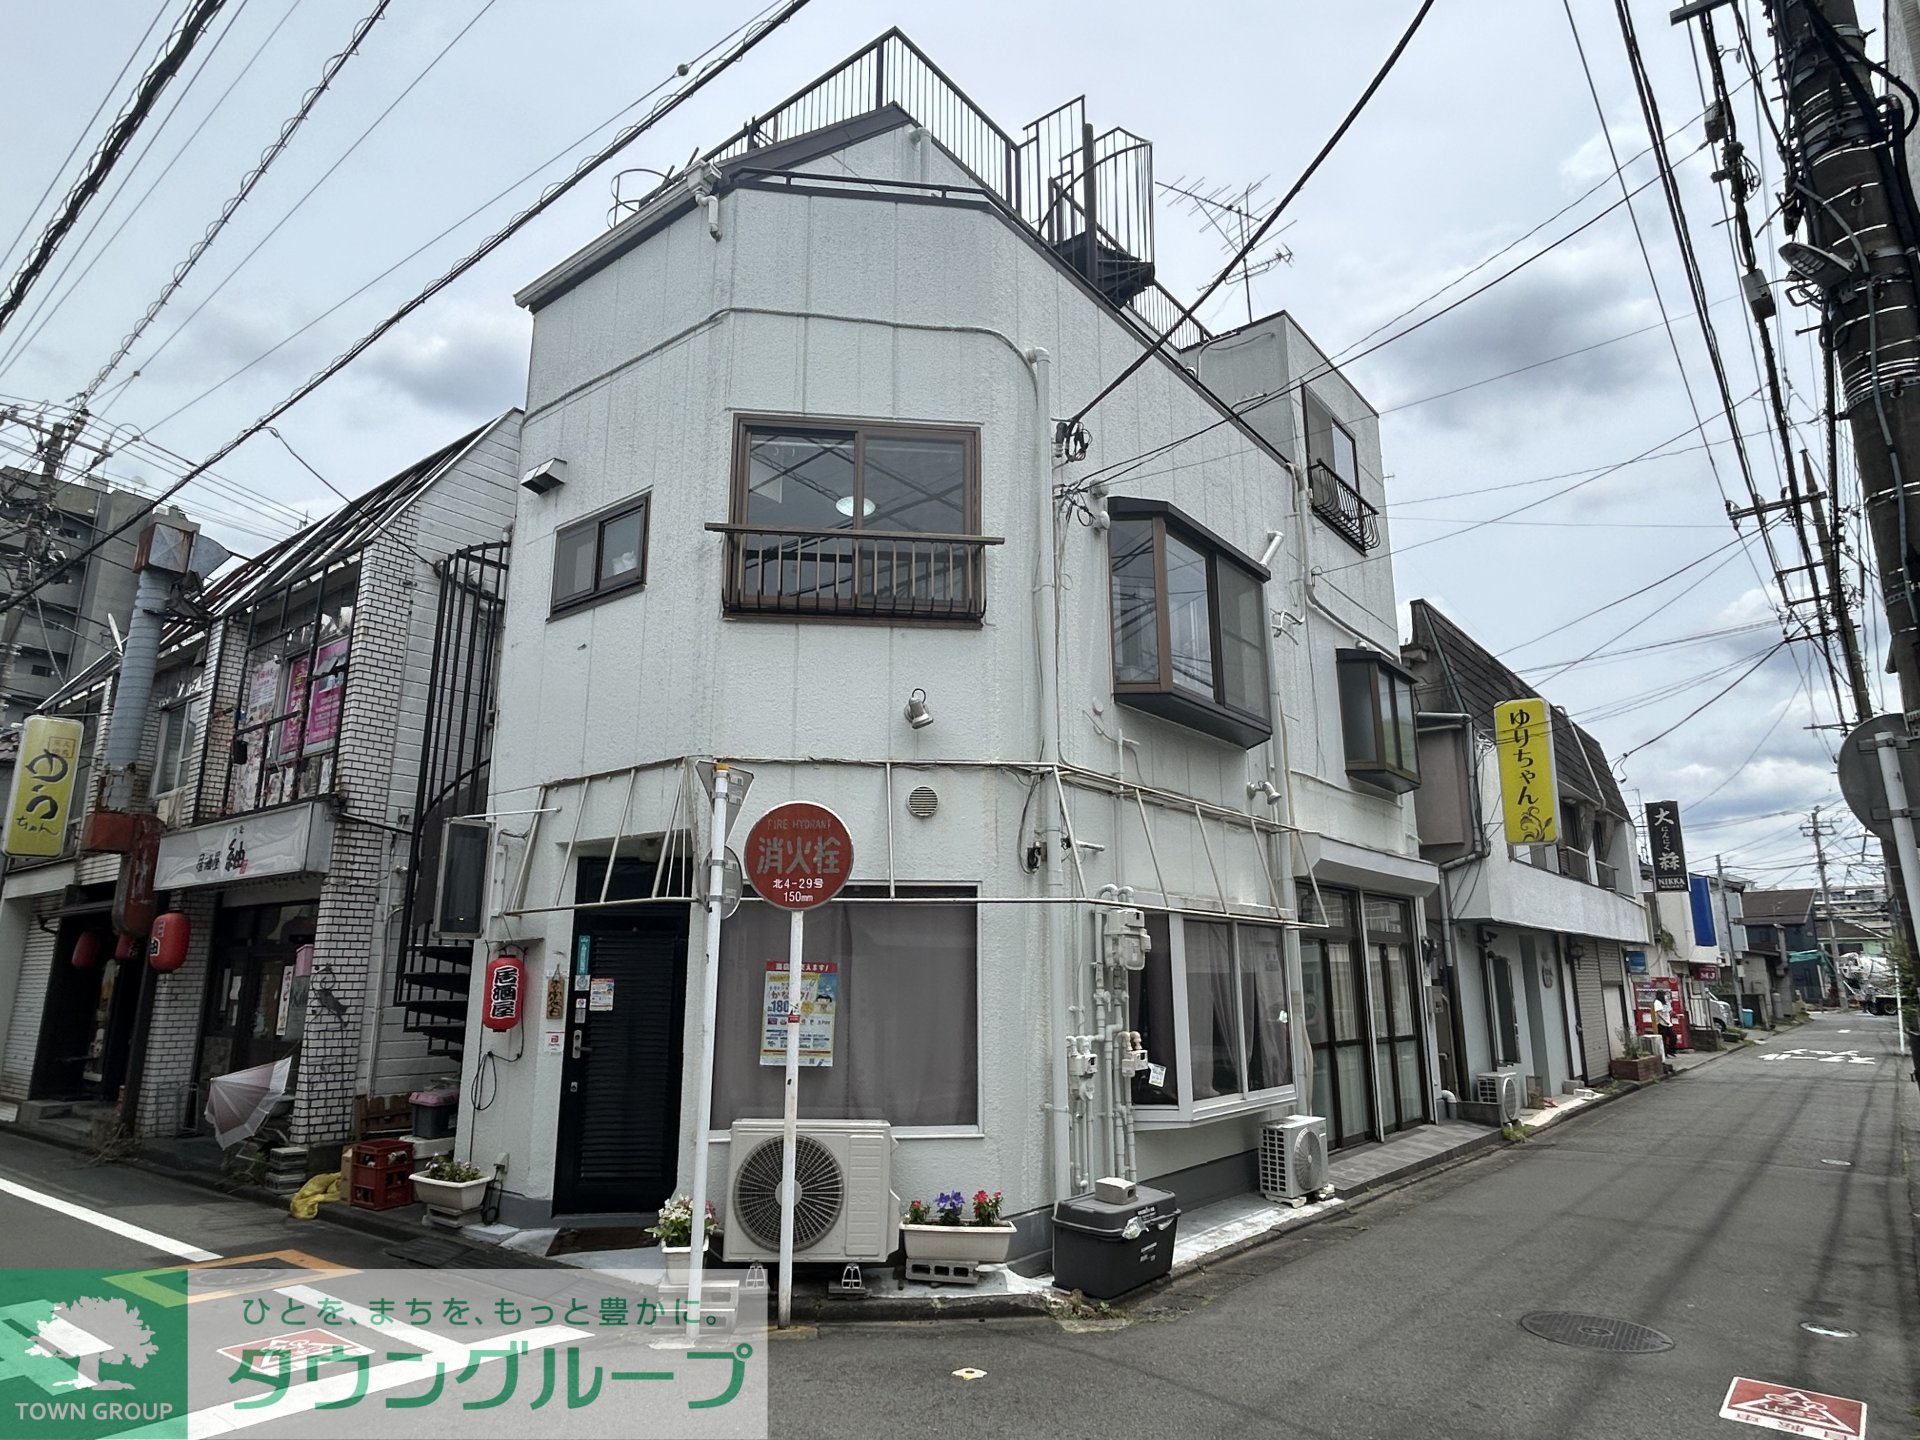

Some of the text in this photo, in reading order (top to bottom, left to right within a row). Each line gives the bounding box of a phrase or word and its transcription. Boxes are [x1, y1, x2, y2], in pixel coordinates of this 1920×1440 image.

[1509, 709, 1539, 805] ゆりちゃん
[768, 819, 831, 829] FIRE HYDRANT
[757, 836, 841, 874] 消火栓
[773, 878, 824, 889] 北4-29号
[1658, 878, 1685, 886] NIKKA
[784, 891, 814, 902] 150mm
[491, 965, 519, 1019] 居酒屋
